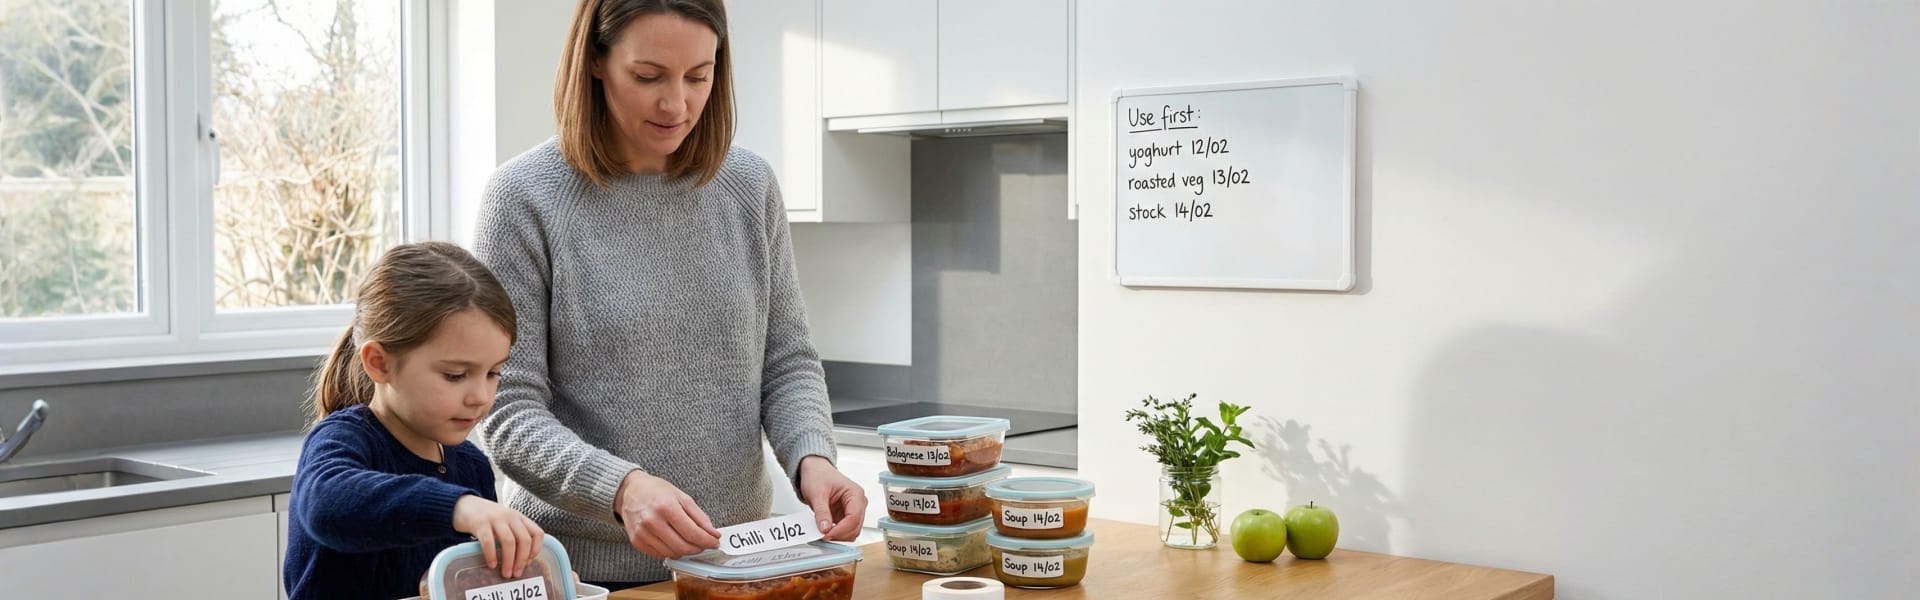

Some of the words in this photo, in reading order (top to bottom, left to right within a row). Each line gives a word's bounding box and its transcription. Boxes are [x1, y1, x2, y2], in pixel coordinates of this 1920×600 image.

[1128, 107, 1155, 127] Use
[1161, 104, 1201, 130] first:
[1129, 140, 1183, 168] yoghurt
[1191, 136, 1230, 159] 12/02
[1128, 172, 1176, 190] roasted
[1182, 175, 1204, 195] veg
[1212, 165, 1251, 188] 13/02
[1129, 203, 1167, 220] stock
[1175, 199, 1214, 222] 14/02
[886, 446, 924, 463] Bolognese
[927, 448, 951, 463] 13/02
[889, 494, 910, 511] Soup
[1004, 510, 1029, 527] Soup
[1033, 511, 1061, 526] 14/02
[729, 529, 765, 549] Chilli
[769, 522, 806, 542] 12/02
[887, 540, 907, 556] Soup
[1004, 557, 1029, 575] Soup
[1033, 560, 1061, 575] 14/02
[509, 583, 543, 600] 12/02
